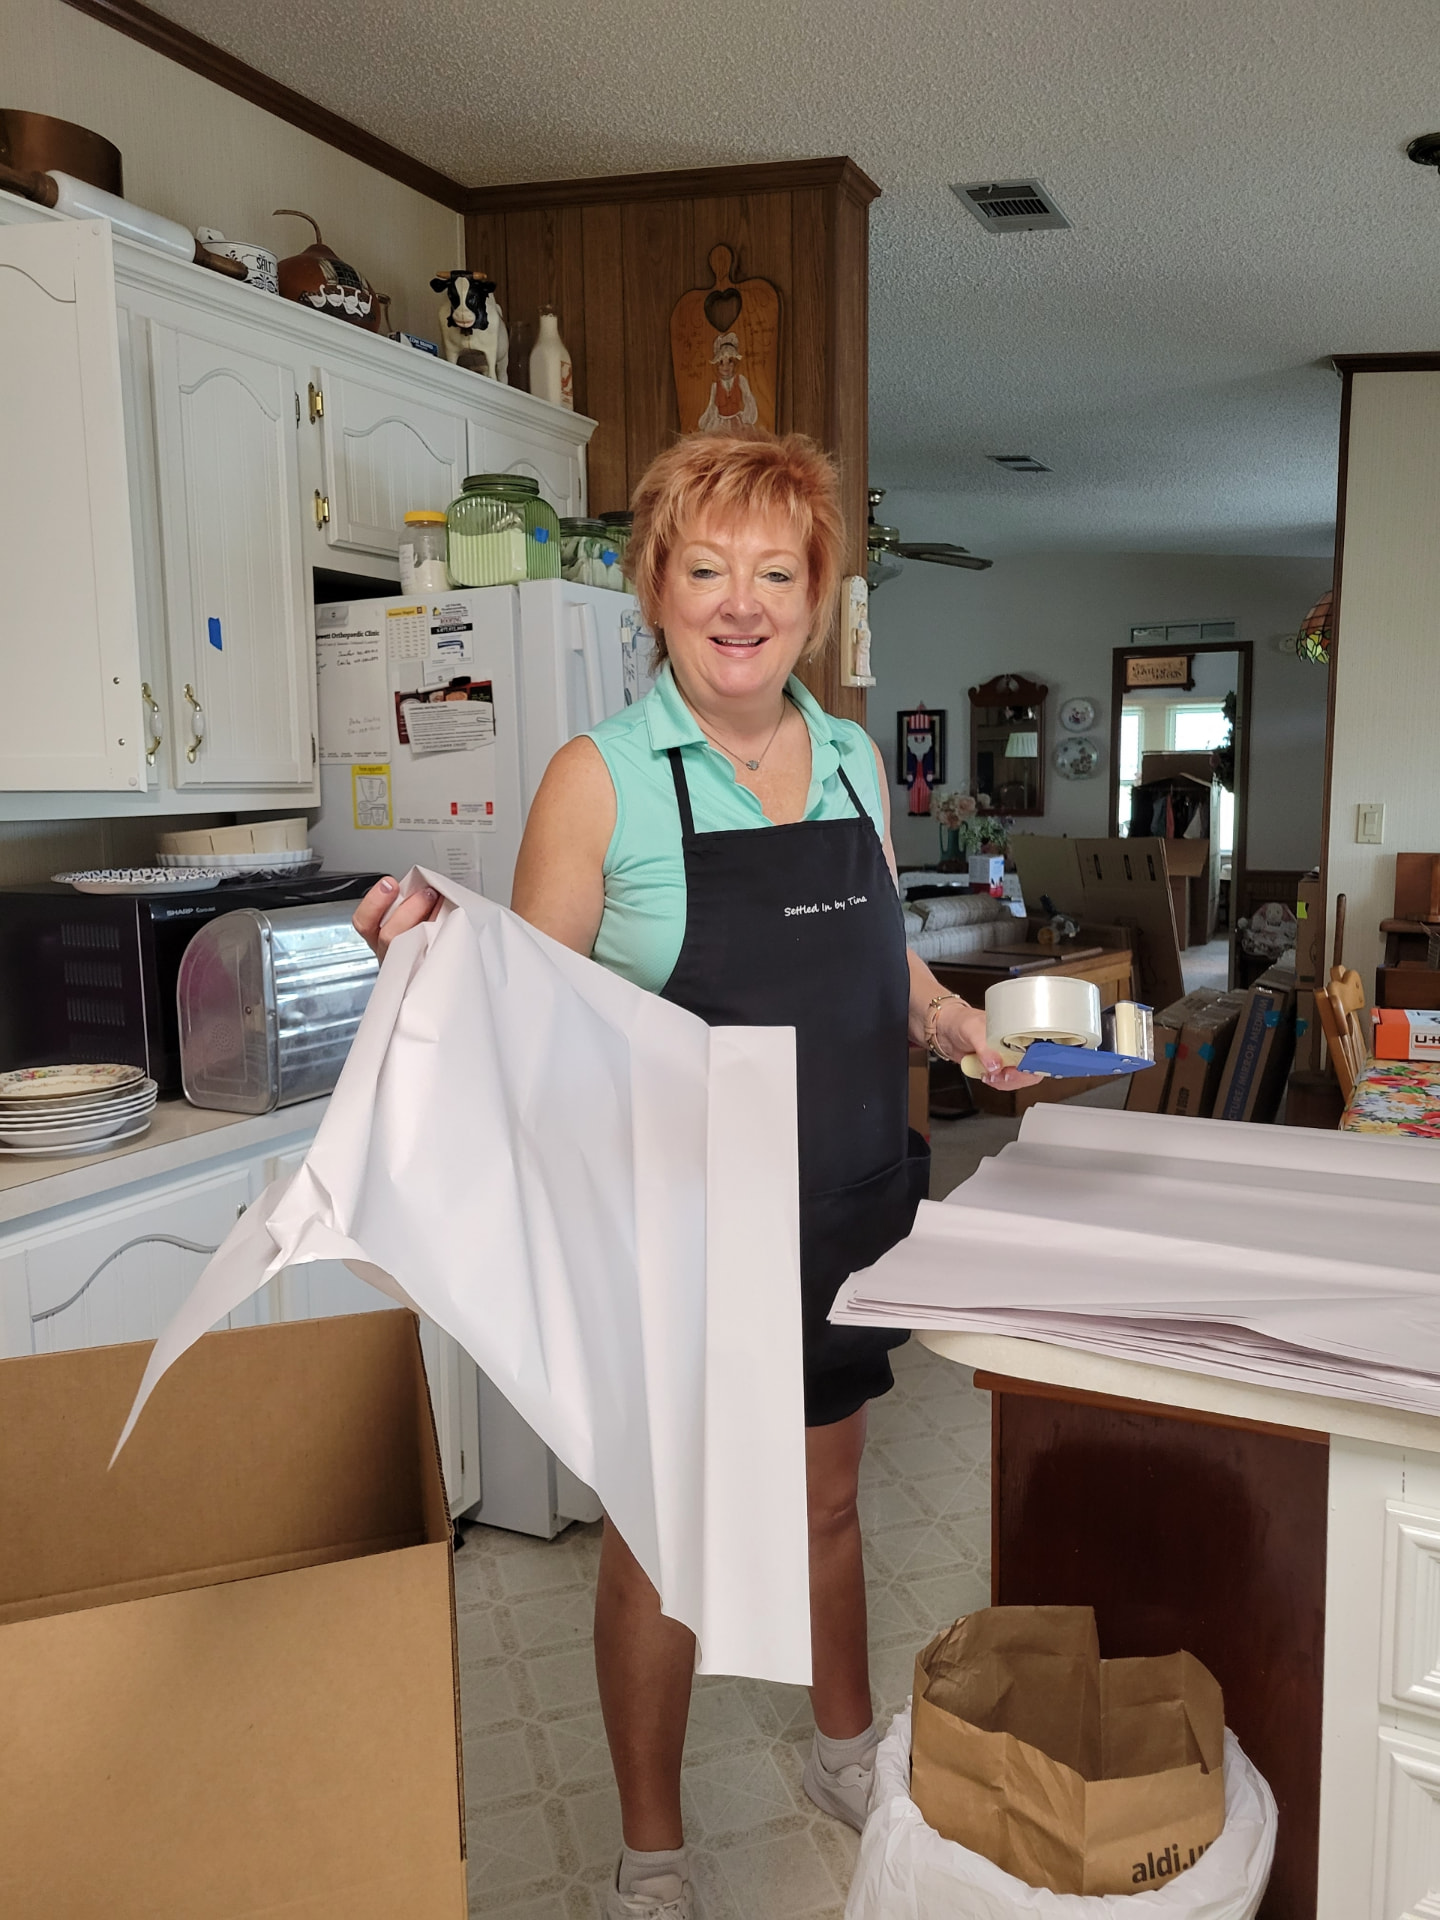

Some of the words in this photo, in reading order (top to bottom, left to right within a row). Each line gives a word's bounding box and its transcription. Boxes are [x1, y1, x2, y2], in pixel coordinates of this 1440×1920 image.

[256, 257, 272, 274] SALT
[331, 631, 364, 640] Orthopaedic
[166, 907, 194, 917] SHARP
[784, 903, 819, 917] Settled
[821, 902, 832, 912] In
[834, 900, 845, 910] by
[847, 895, 867, 906] Tina
[1132, 1843, 1214, 1884] aldi.u
